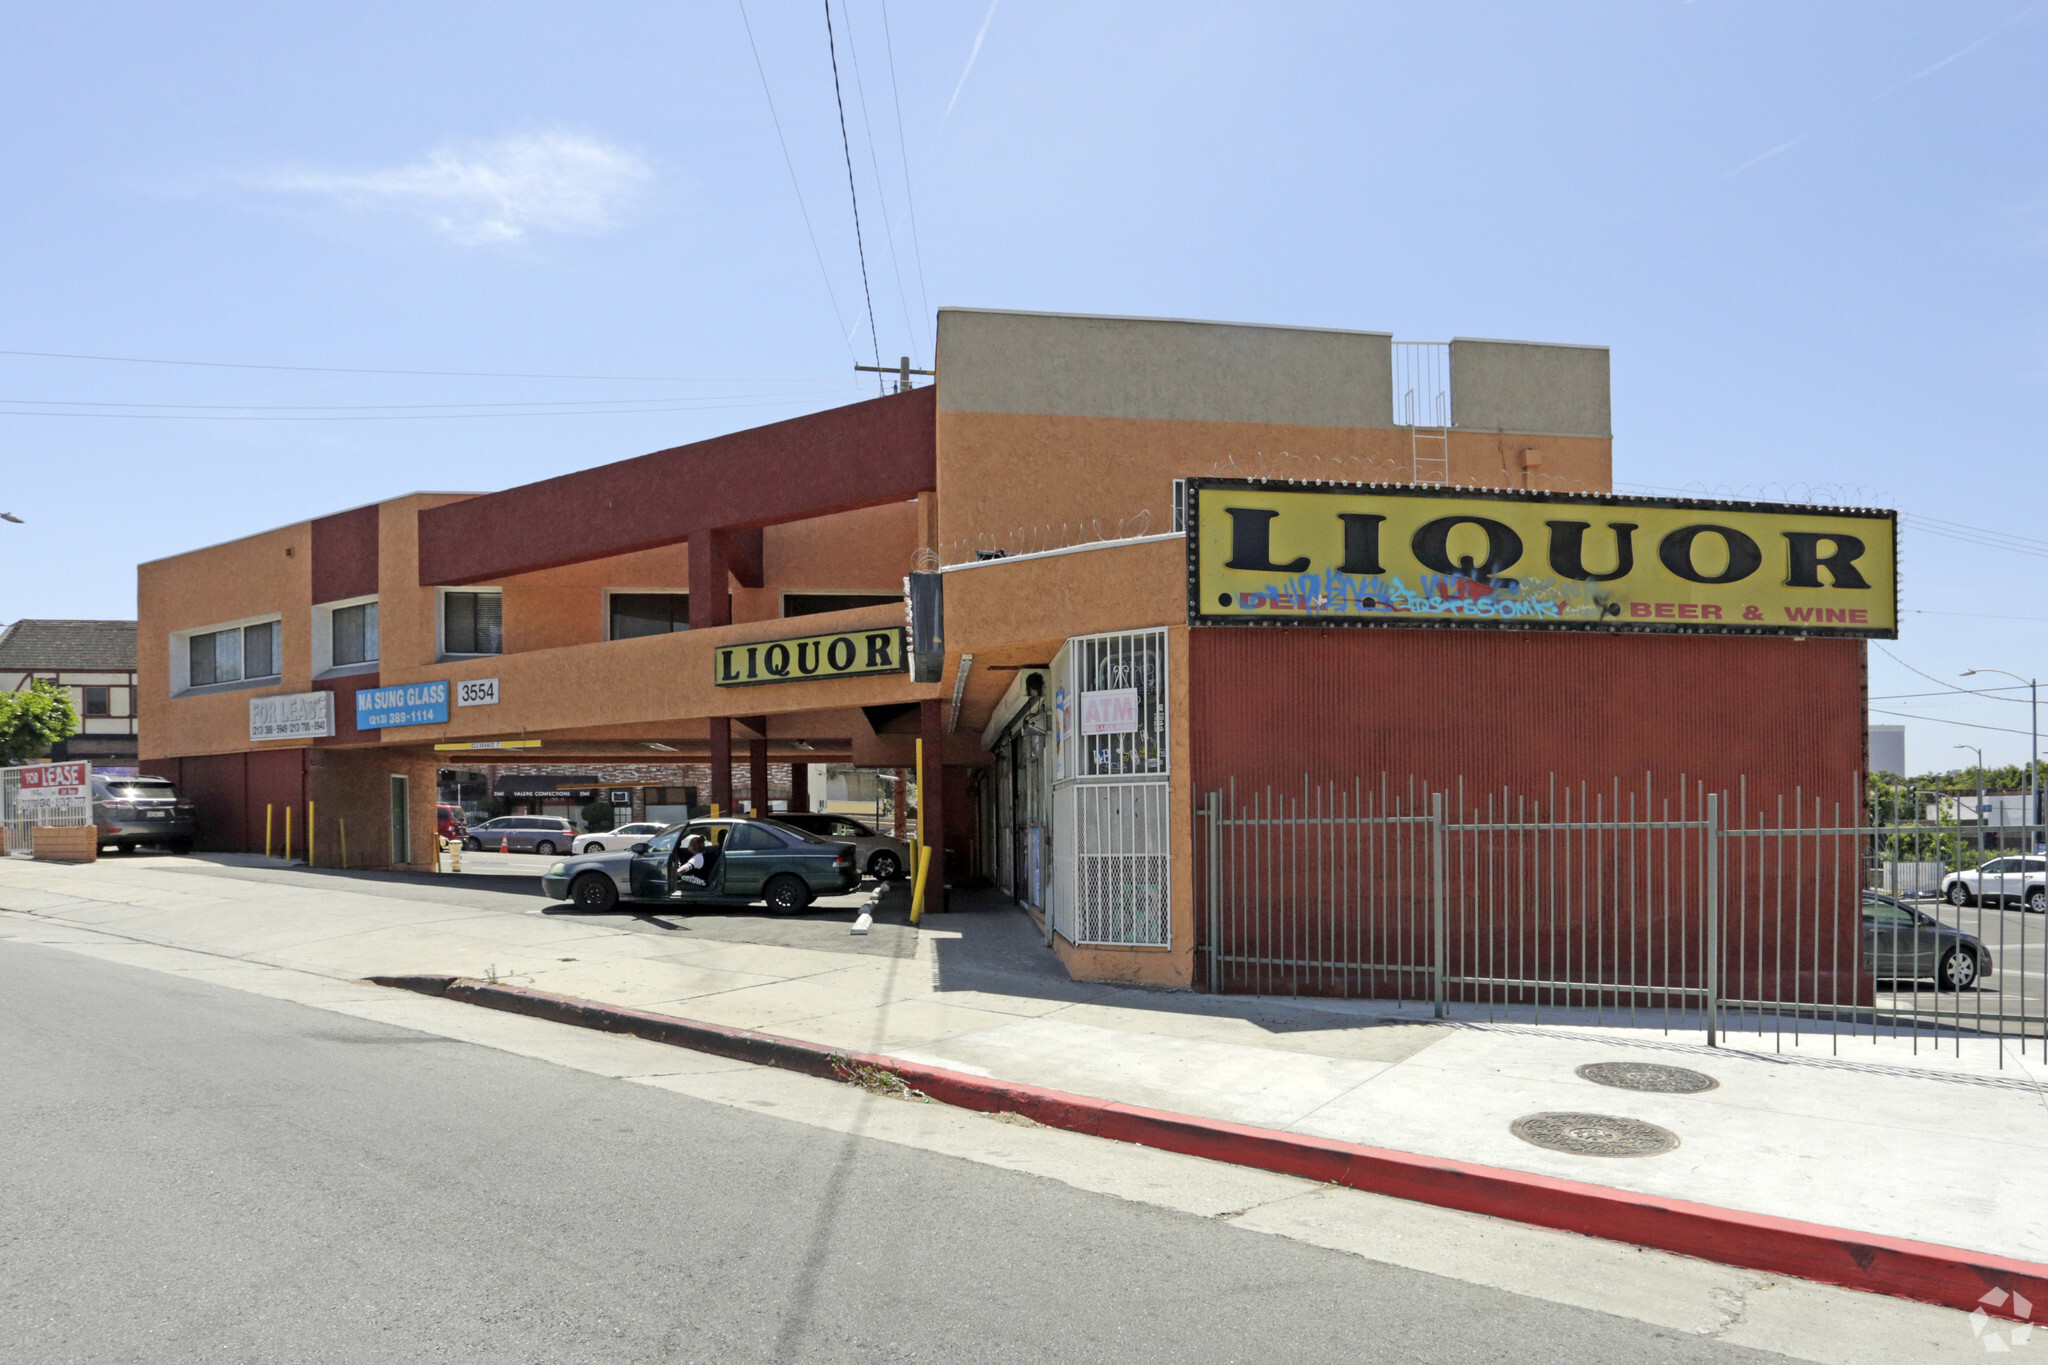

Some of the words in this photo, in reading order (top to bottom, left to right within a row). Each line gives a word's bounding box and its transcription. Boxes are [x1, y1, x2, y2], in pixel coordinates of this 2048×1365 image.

[1223, 506, 1873, 590] LIQUOR
[1630, 601, 1723, 620] BEER
[1741, 605, 1765, 621] &
[1783, 606, 1869, 624] WINE
[721, 632, 893, 681] LIQUOR
[374, 688, 404, 710] SUNG
[406, 683, 445, 705] GLASS
[461, 682, 495, 702] 3554
[252, 702, 278, 724] FOR
[281, 696, 326, 722] LEASE
[368, 714, 388, 726] (213)
[1085, 698, 1134, 723] ATM
[25, 772, 39, 784] FOR
[42, 765, 79, 786] LEASE
